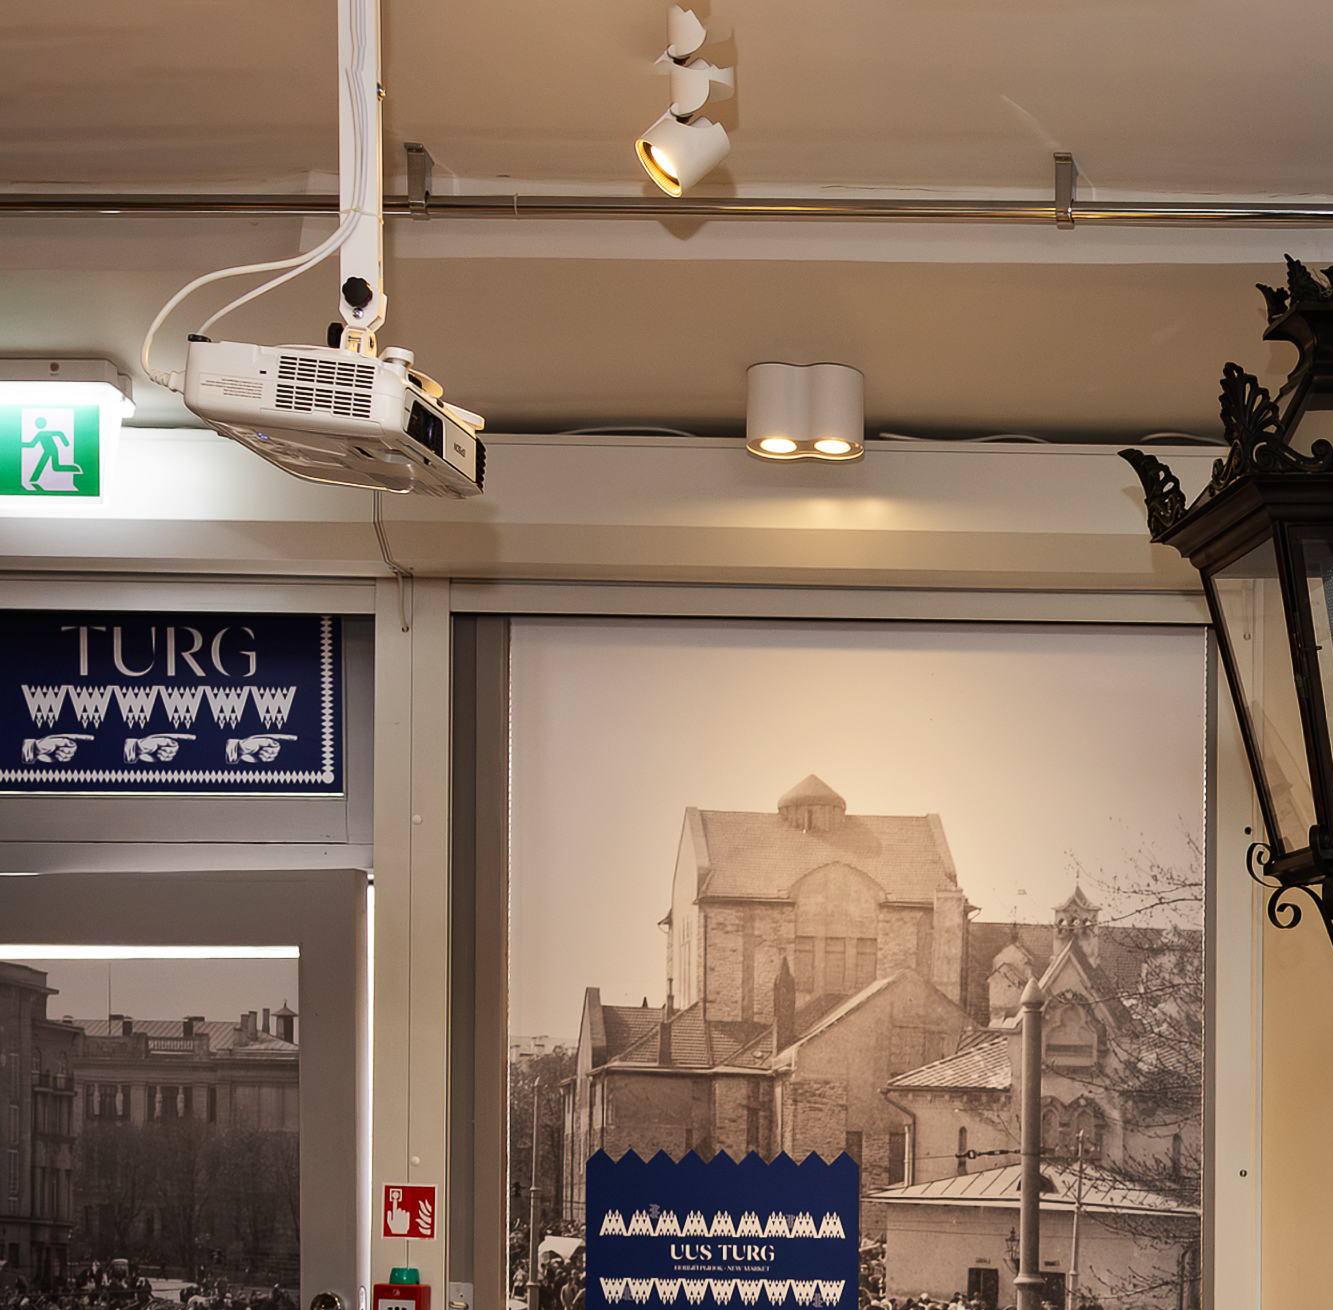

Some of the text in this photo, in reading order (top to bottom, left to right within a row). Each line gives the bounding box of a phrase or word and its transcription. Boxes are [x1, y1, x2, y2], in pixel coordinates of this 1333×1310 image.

[61, 626, 257, 677] TURG
[670, 1244, 775, 1262] UUS TURG
